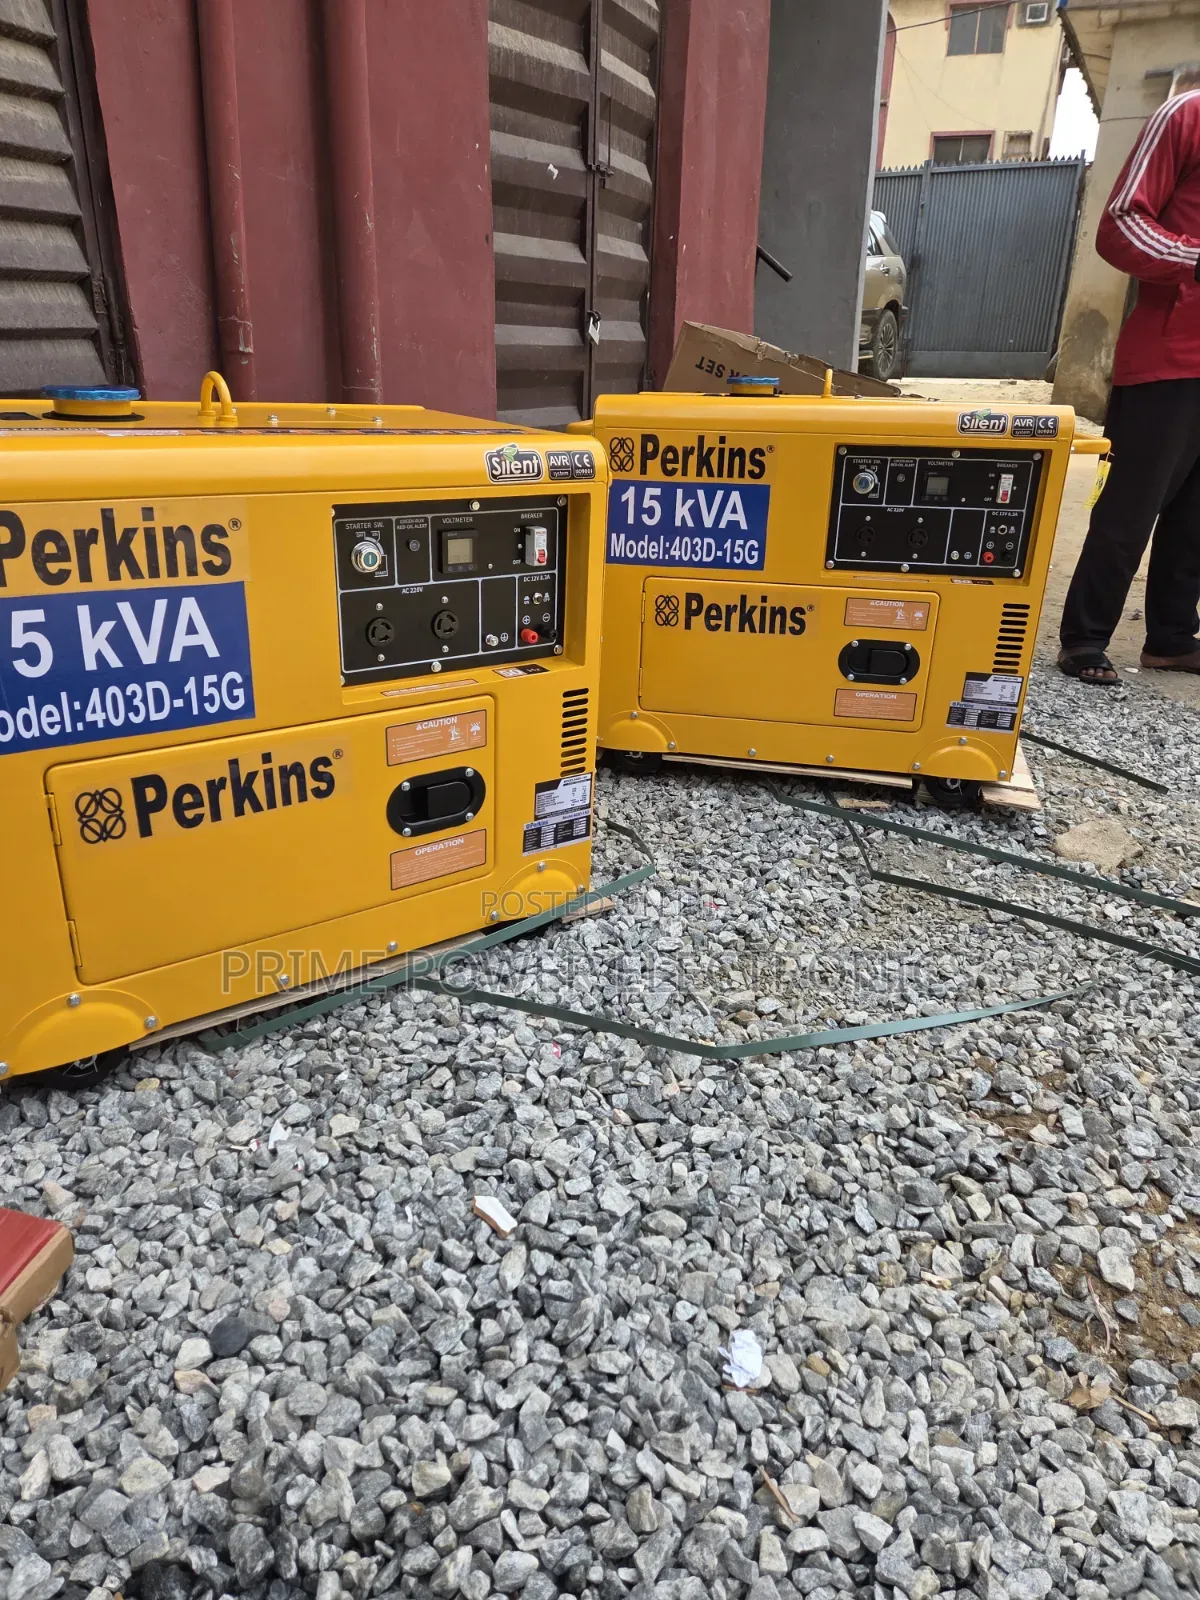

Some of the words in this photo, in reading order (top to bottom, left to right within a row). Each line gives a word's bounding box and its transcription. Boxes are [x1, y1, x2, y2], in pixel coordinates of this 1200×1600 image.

[695, 356, 726, 379] SET
[961, 415, 1006, 430] Silent
[1014, 418, 1033, 427] AVR
[491, 455, 539, 476] Silent
[549, 455, 570, 467] AVR
[620, 485, 662, 526] 15
[674, 488, 748, 530] kVA
[441, 516, 473, 524] VOLTMETER
[520, 512, 543, 520] BREAKER
[345, 522, 372, 530] STARTER
[610, 532, 759, 565] Model:403D-15G
[875, 600, 905, 608] CAUTION
[11, 608, 54, 678] 5
[76, 596, 221, 672] kVA
[855, 691, 897, 700] OPERATION
[0, 671, 245, 743] odel:403D-15G
[422, 716, 458, 730] CAUTION
[415, 837, 465, 856] OPERATION
